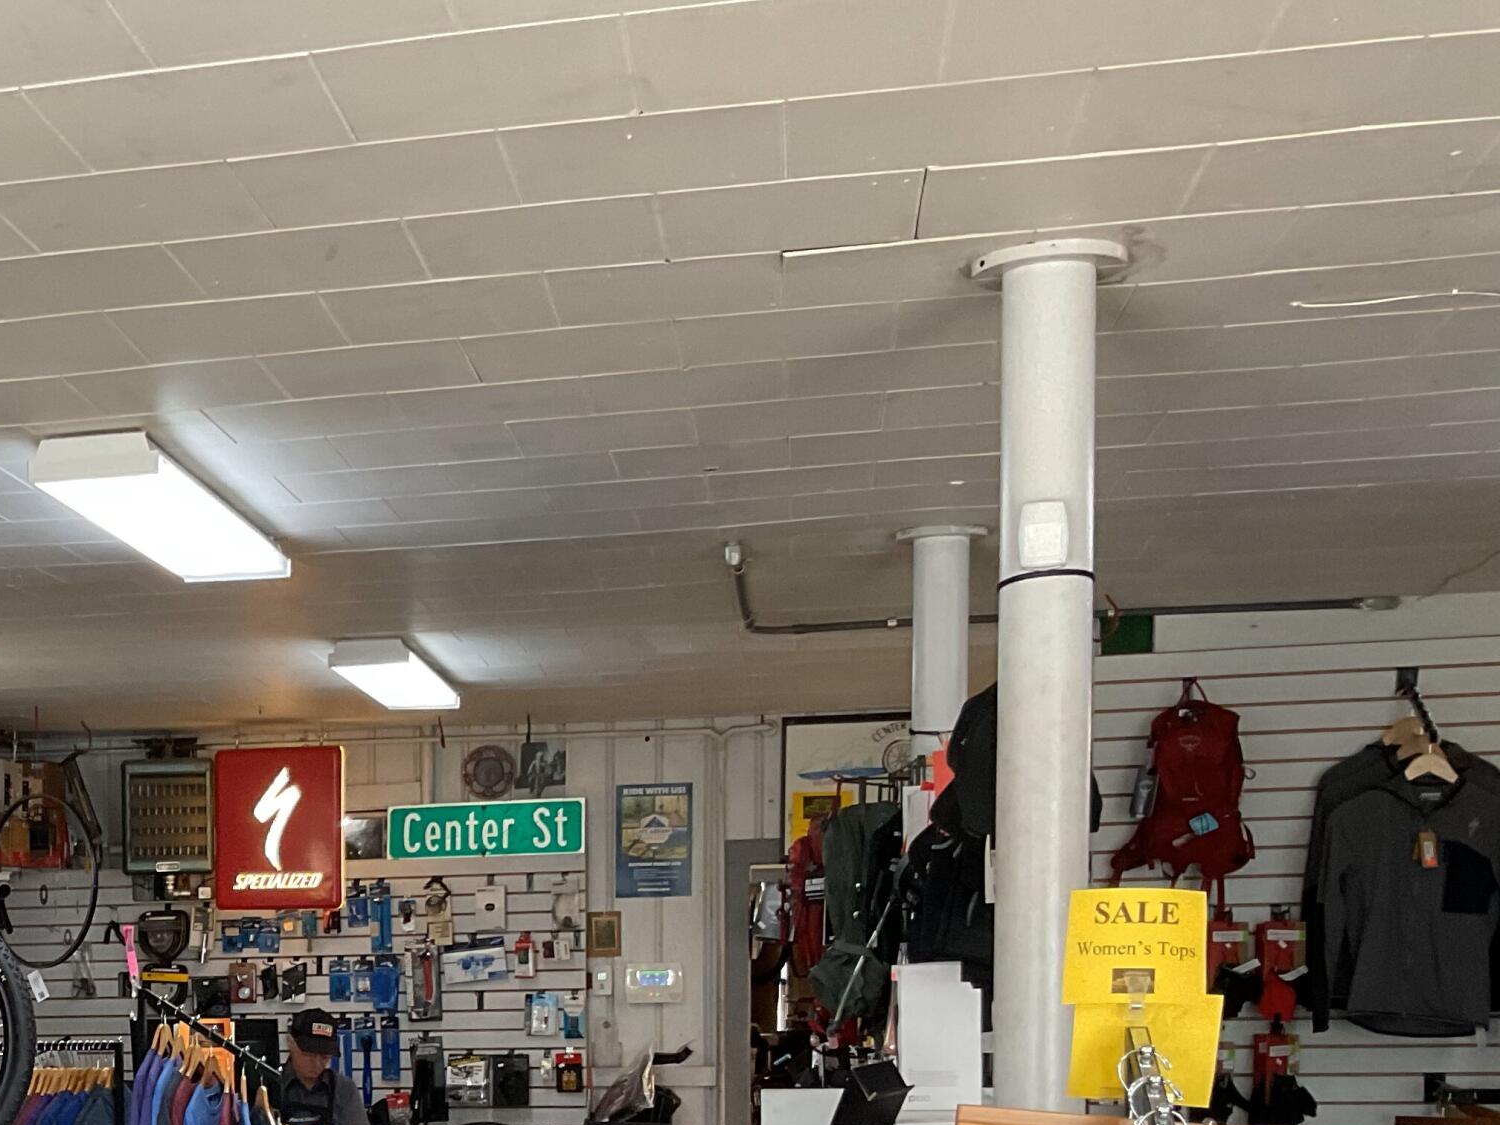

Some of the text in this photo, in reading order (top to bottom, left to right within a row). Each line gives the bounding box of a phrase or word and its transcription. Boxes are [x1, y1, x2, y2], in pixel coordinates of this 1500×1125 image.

[403, 807, 568, 853] Center St
[233, 872, 323, 890] SPECIALIZED
[1094, 901, 1181, 925] SALE
[1077, 940, 1197, 960] Women's Tops
